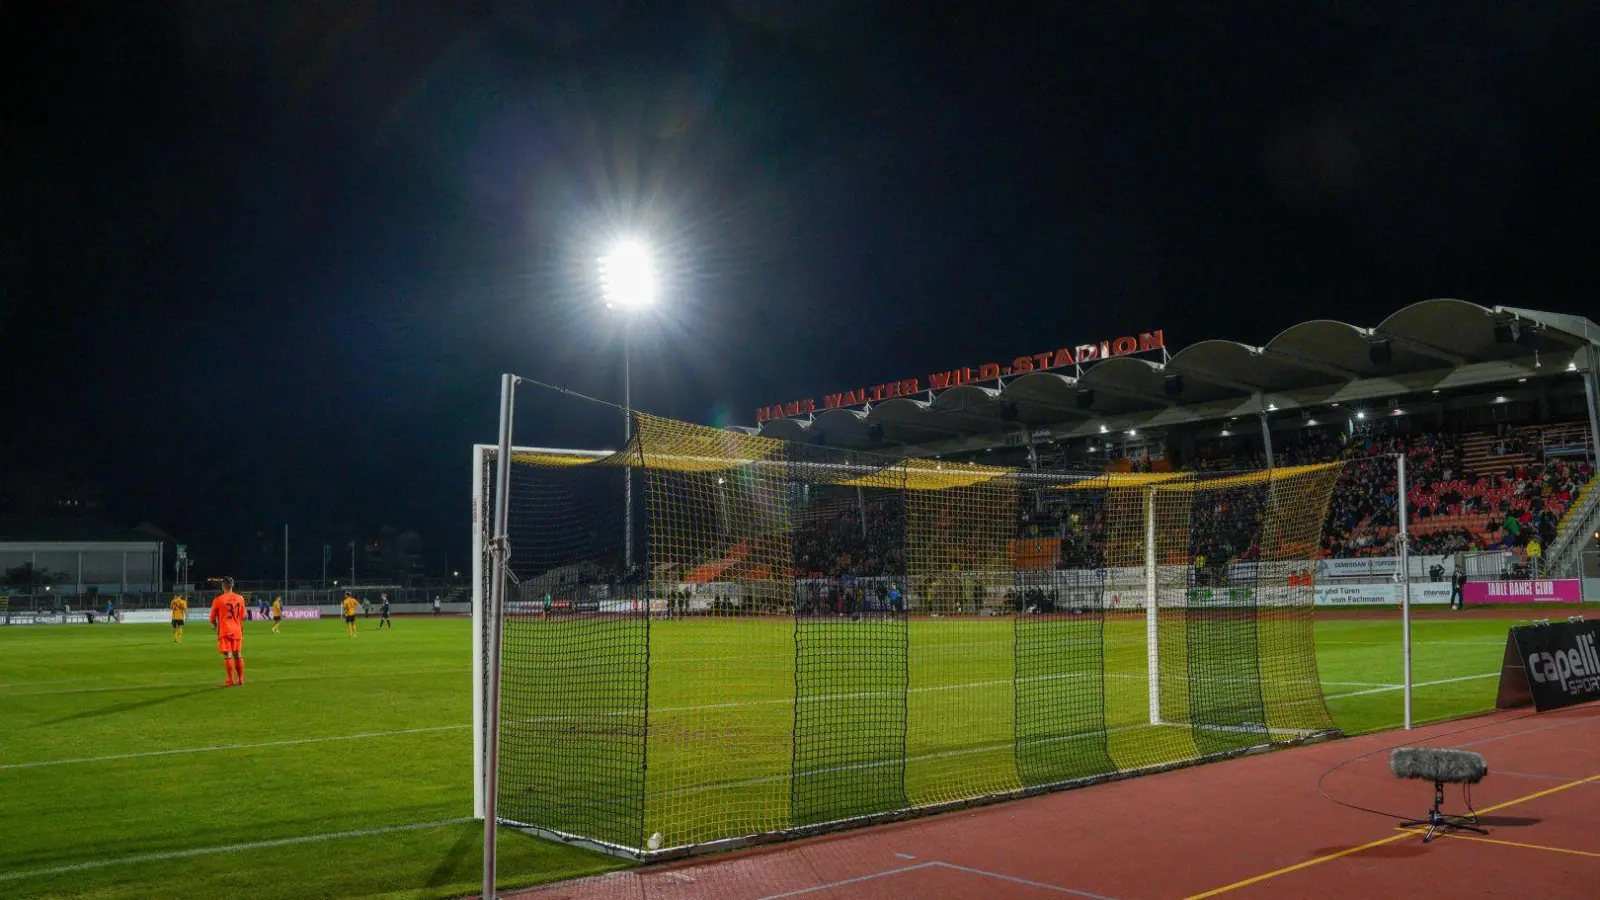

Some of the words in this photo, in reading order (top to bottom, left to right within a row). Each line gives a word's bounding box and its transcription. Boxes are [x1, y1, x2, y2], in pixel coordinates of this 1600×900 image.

[756, 399, 815, 421] HANS
[824, 378, 919, 409] WALTER
[1340, 586, 1360, 594] Türen
[1488, 582, 1507, 595] TABLE
[1509, 582, 1533, 595] DANCE
[1535, 582, 1554, 595] CLUB
[1348, 595, 1385, 603] Fachmann
[294, 610, 319, 619] SPORT
[1529, 633, 1600, 692] capelli
